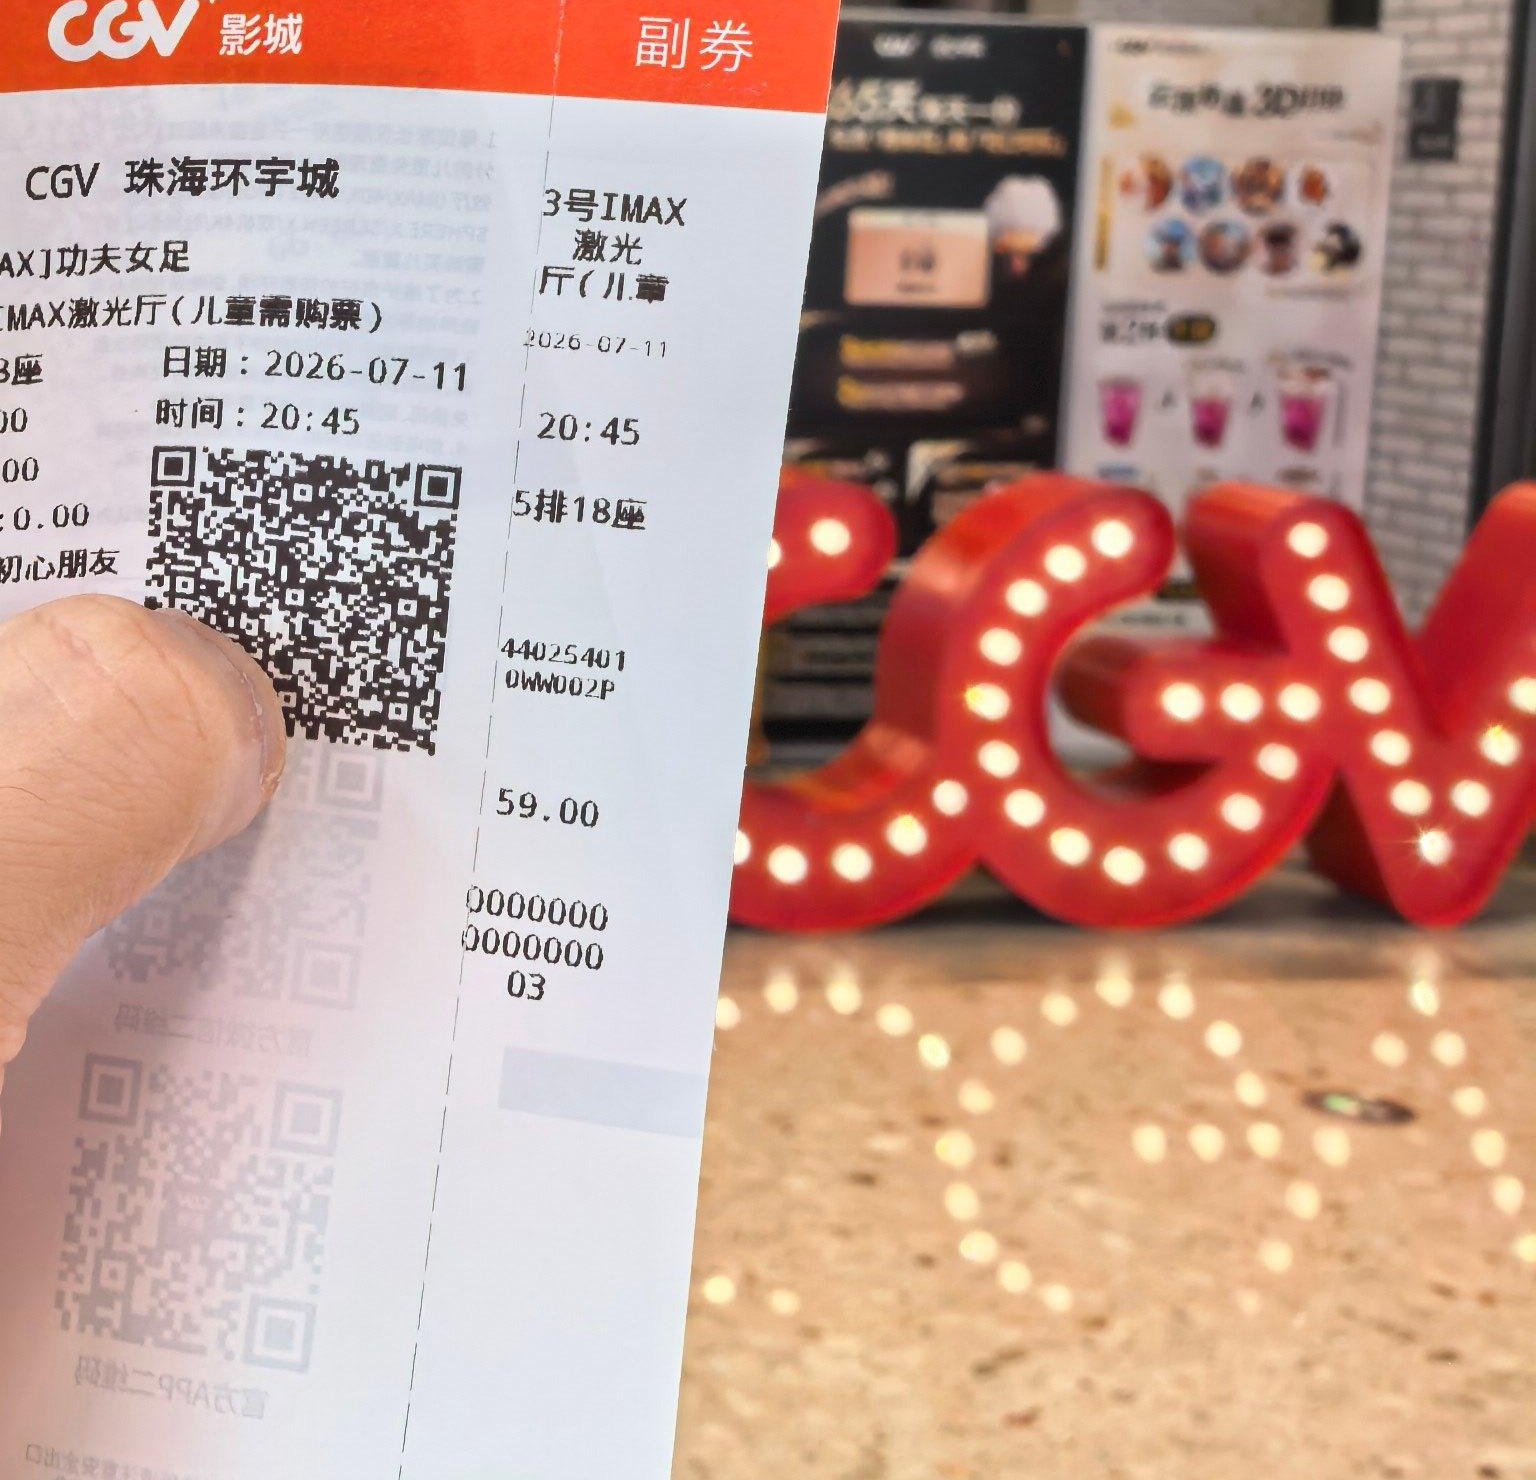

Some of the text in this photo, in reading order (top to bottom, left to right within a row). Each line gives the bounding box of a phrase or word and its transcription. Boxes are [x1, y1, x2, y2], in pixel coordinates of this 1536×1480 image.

[219, 13, 303, 56] 影城
[636, 16, 753, 72] 副券
[25, 162, 101, 201] CGV
[123, 155, 340, 199] 珠海环宇城
[542, 188, 688, 227] 3号IMAX
[572, 227, 643, 266] 激光
[522, 327, 666, 359] 2026-07-11
[163, 345, 466, 392] 日期：2026-07-11
[155, 396, 360, 436] 时间：20:45
[536, 411, 640, 446] 20:45
[512, 488, 647, 531] 5排18座
[500, 637, 626, 672] 44025401
[496, 787, 600, 828] 59.00
[465, 885, 609, 932] 0000000
[461, 923, 604, 971] 0000000
[507, 969, 546, 1001] 03
